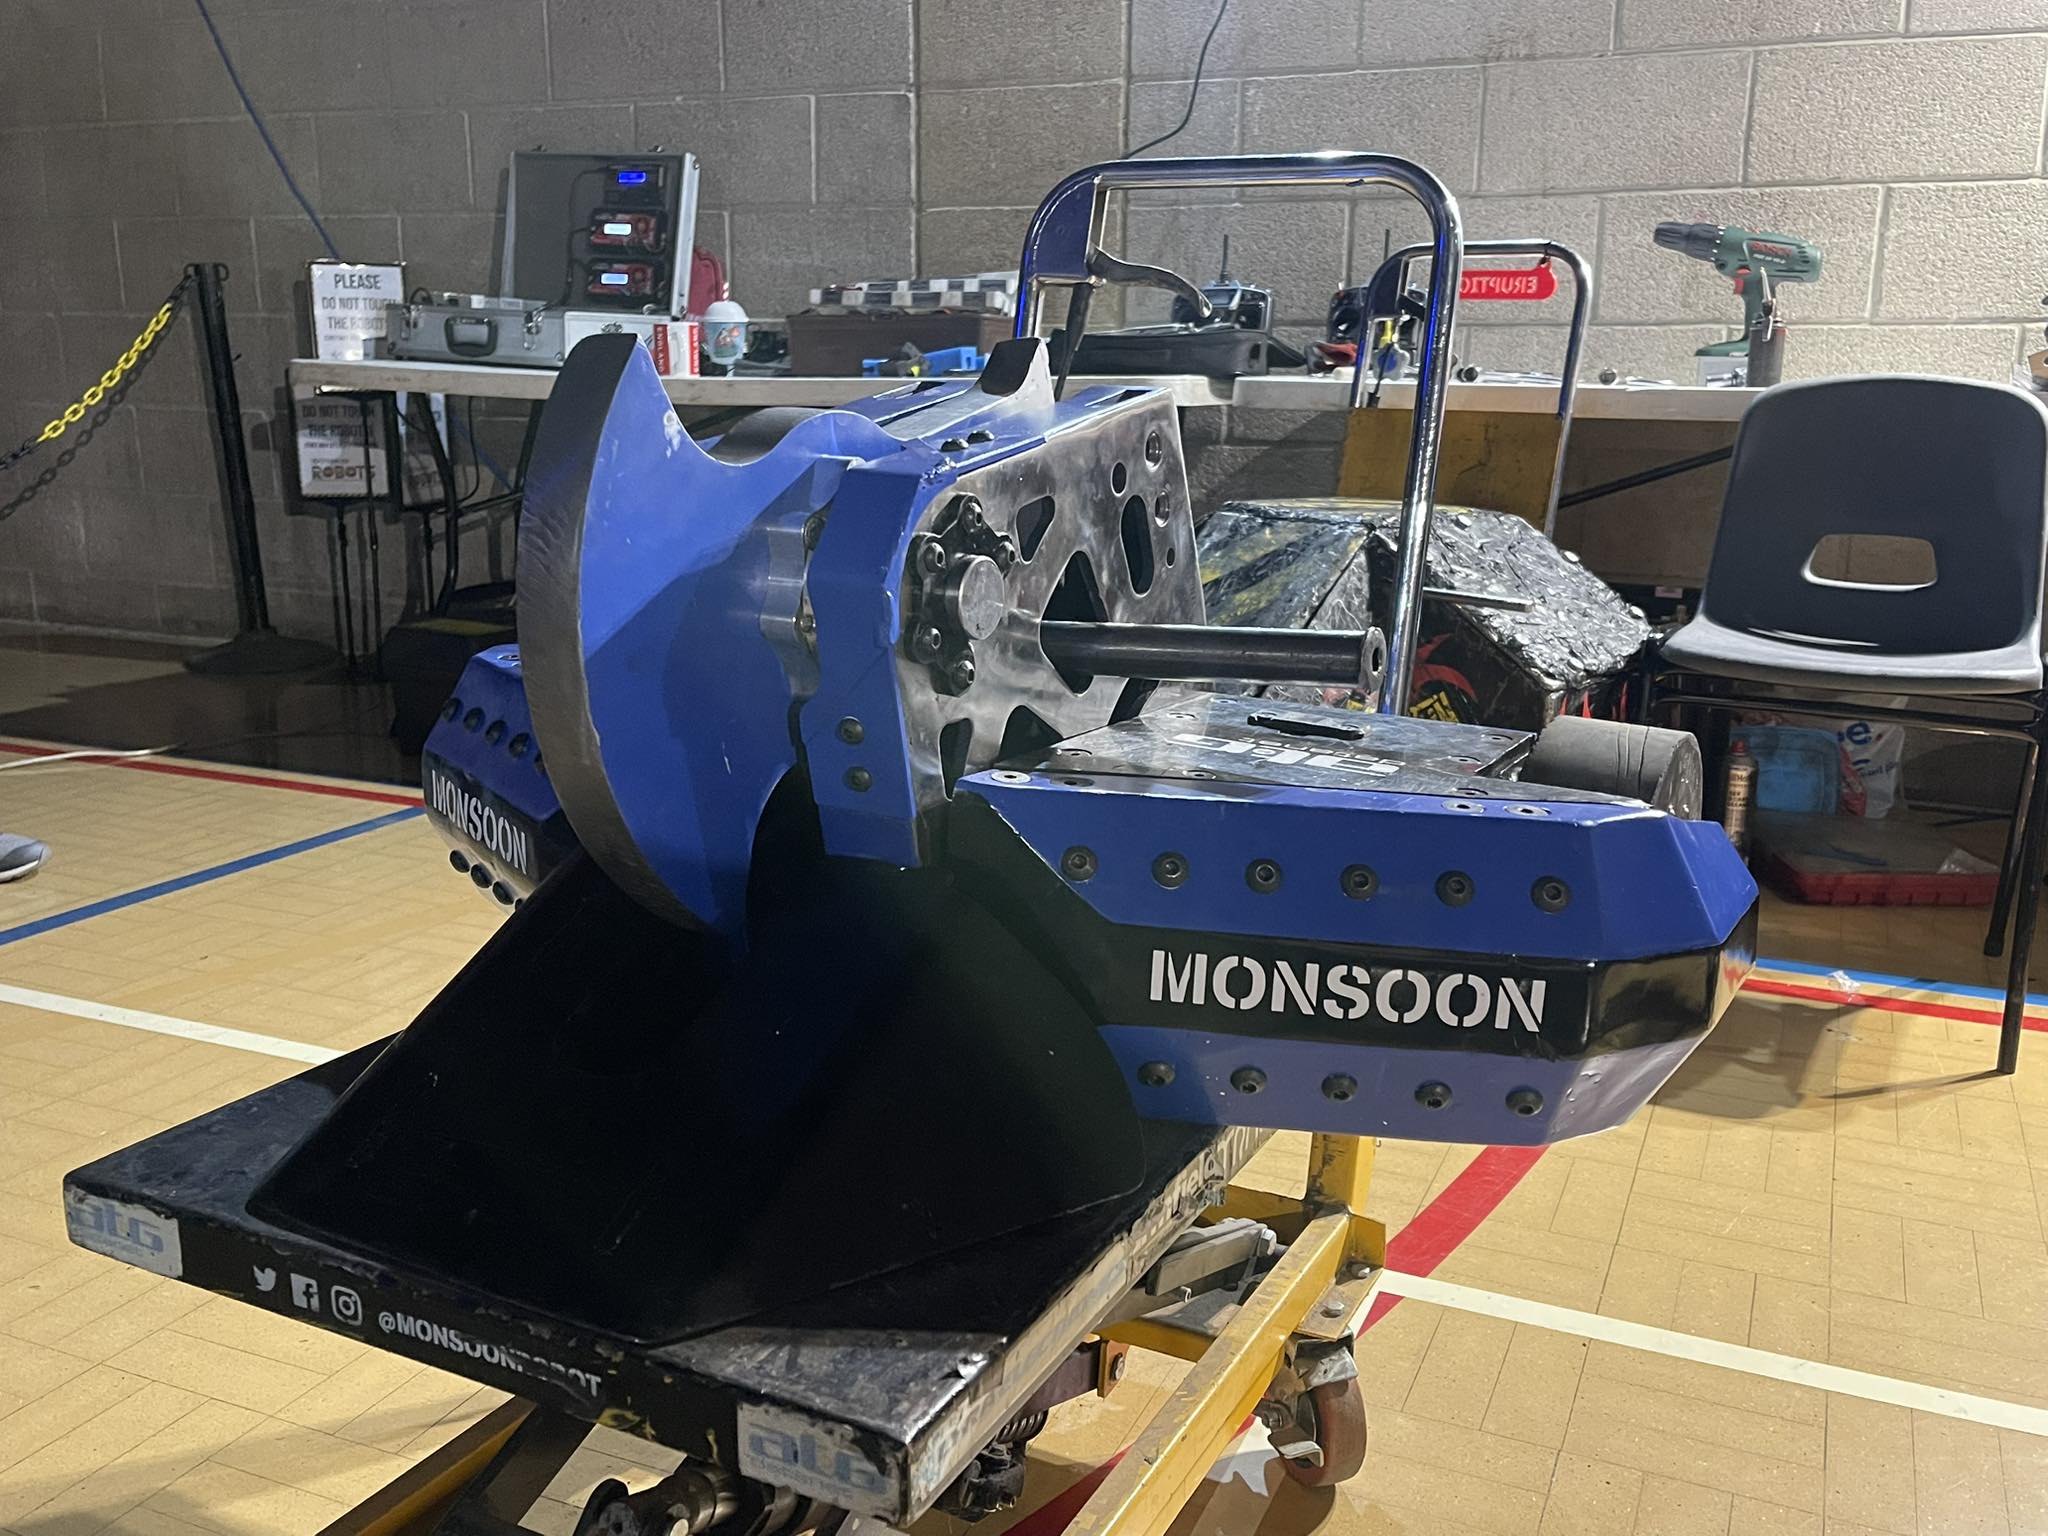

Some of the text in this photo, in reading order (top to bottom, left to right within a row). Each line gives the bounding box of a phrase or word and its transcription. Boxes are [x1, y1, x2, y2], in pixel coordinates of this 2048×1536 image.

[321, 296, 337, 310] DO
[339, 297, 359, 310] NOT
[333, 273, 382, 290] PLEASE
[328, 316, 349, 330] THE
[431, 769, 527, 876] MONSOON
[1149, 949, 1548, 1033] MONSOON
[378, 1311, 602, 1398] @MONSOONOT
